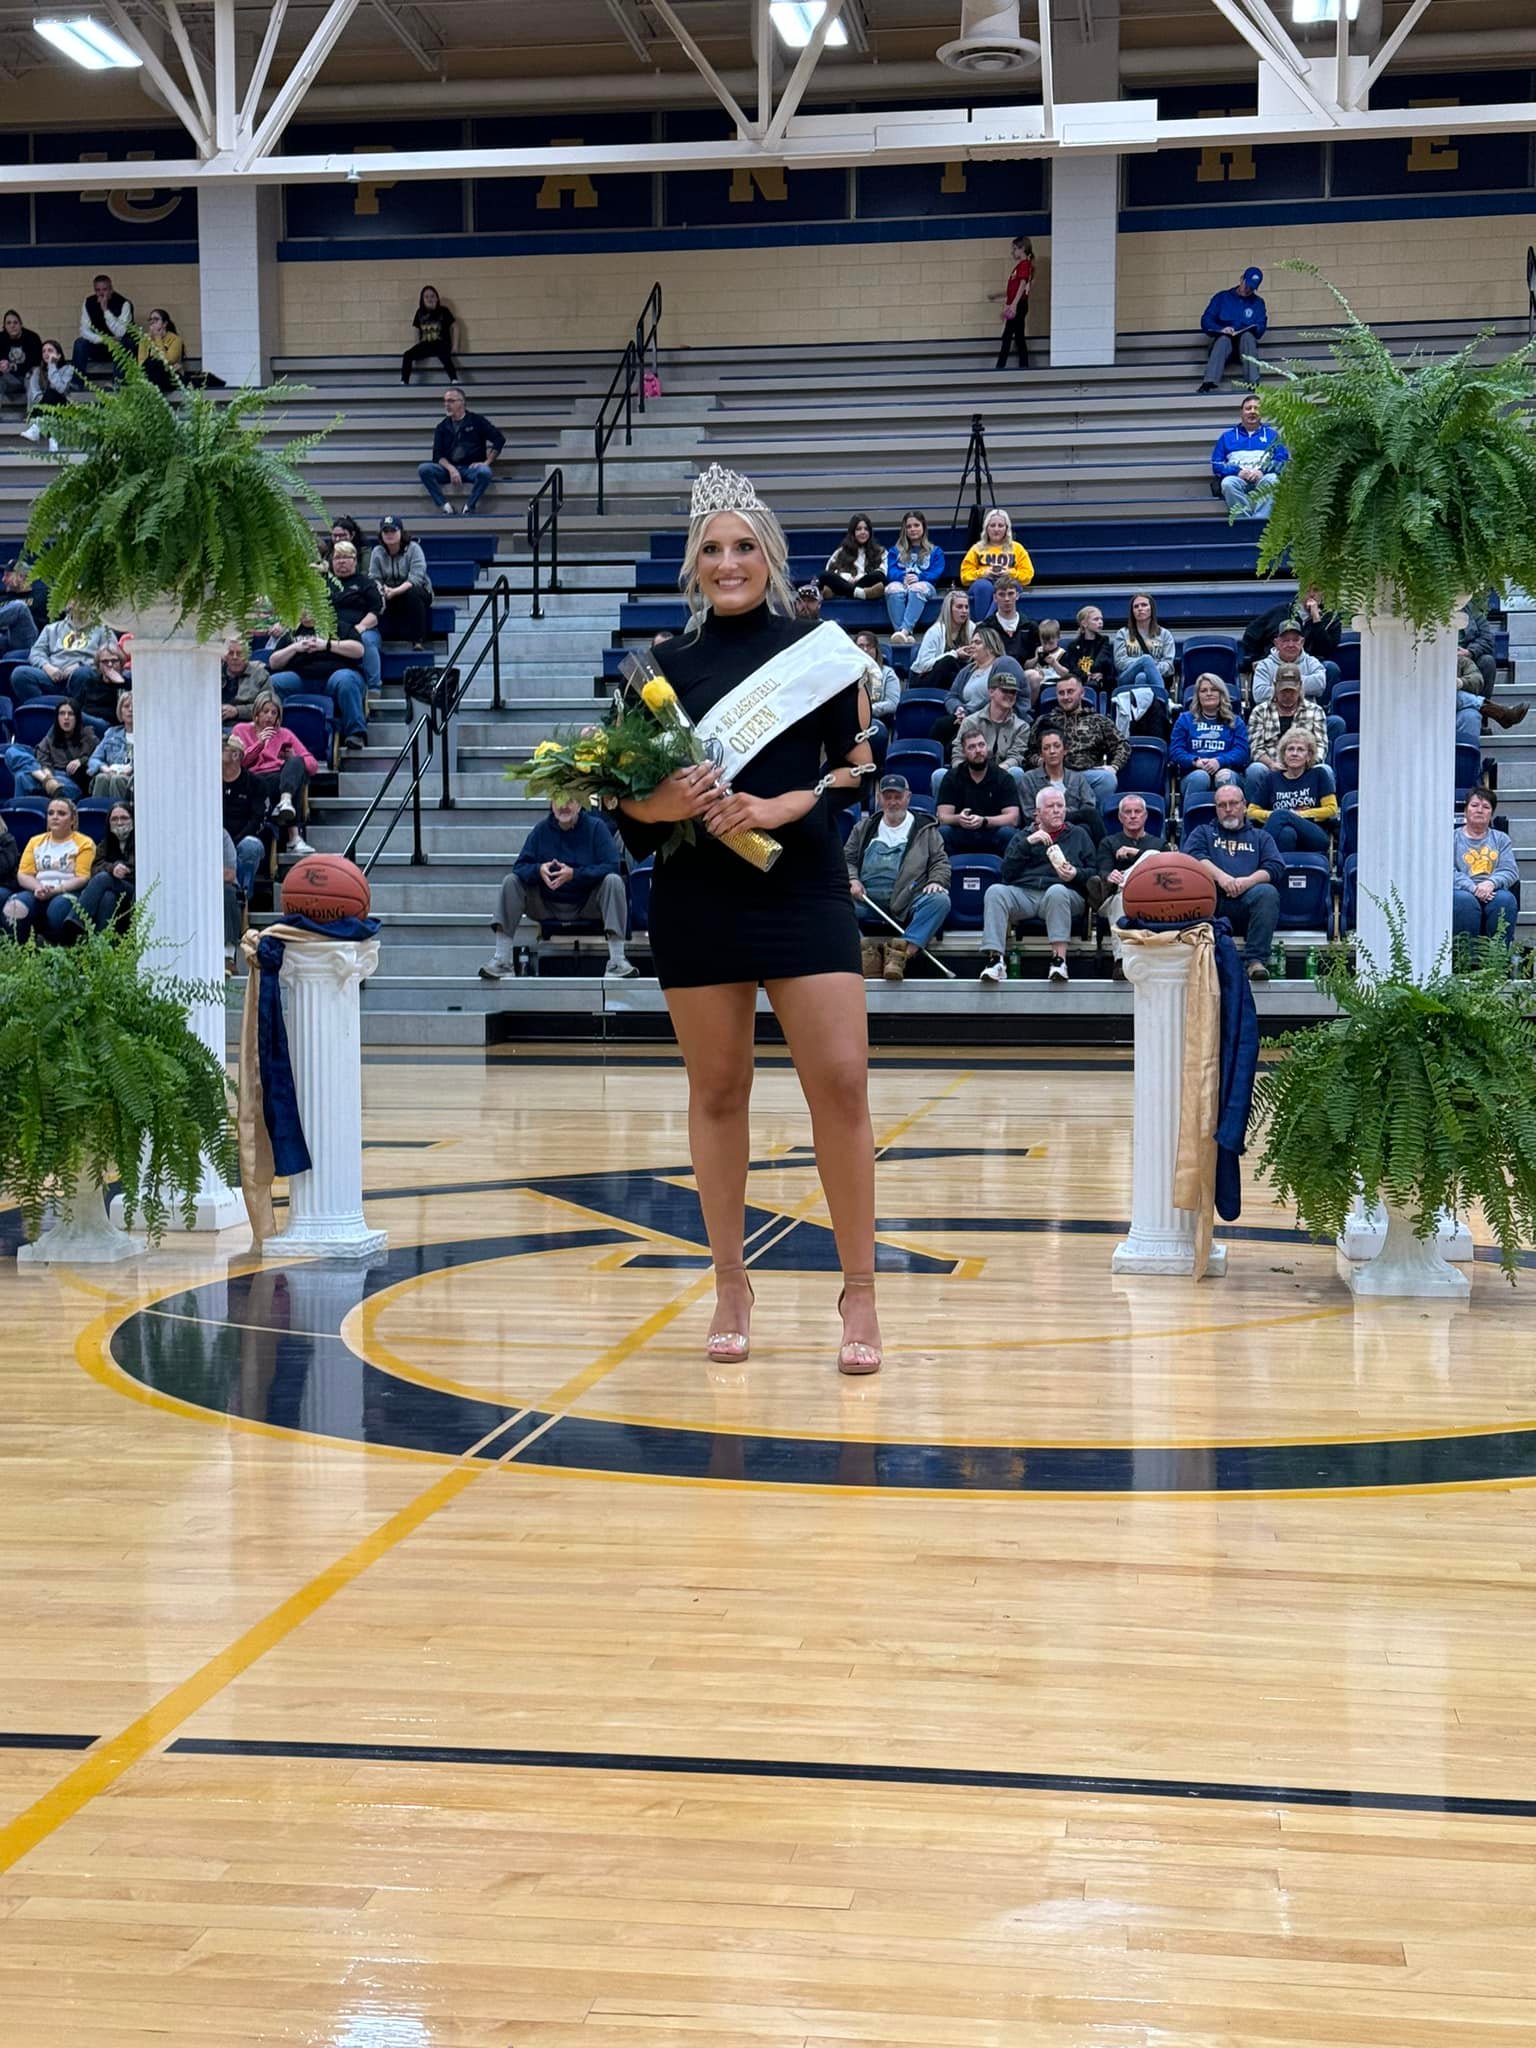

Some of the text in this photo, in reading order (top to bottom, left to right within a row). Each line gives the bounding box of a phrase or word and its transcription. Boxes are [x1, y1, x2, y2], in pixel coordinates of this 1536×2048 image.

[732, 678, 781, 719] BASKETBALL
[729, 704, 780, 754] QUEEN
[1196, 721, 1224, 731] BLUE
[1299, 787, 1311, 797] MY
